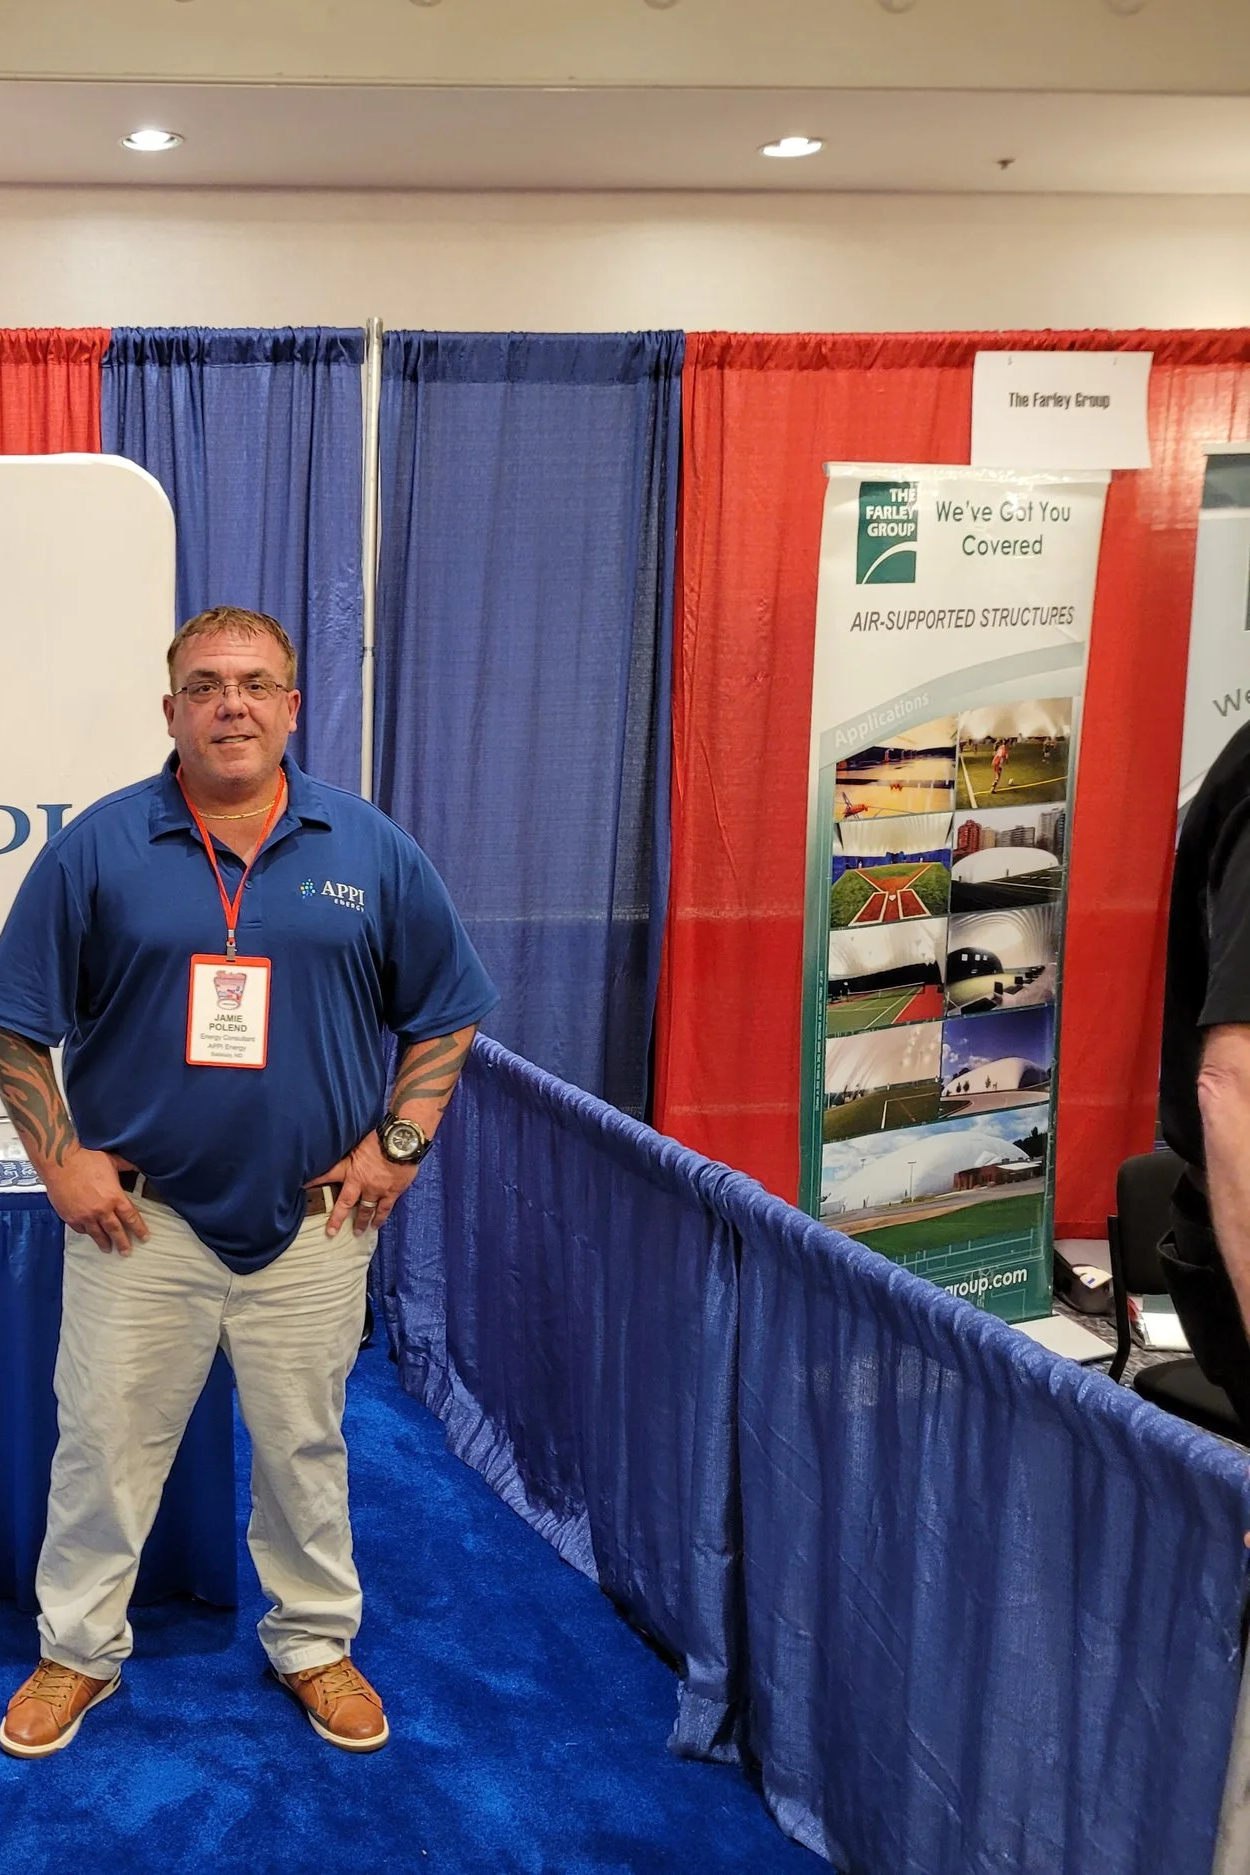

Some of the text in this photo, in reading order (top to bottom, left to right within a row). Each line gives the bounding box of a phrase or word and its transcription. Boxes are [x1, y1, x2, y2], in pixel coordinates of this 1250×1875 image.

[1008, 392, 1111, 411] The Farley Group
[889, 487, 918, 503] THE
[865, 504, 919, 521] FARLEY
[936, 500, 1071, 523] We've Got You
[866, 522, 916, 538] GROUP
[961, 534, 1043, 556] Covered
[850, 606, 1075, 633] AIR-SUPPORTED STRUCTURES
[834, 691, 930, 749] Applications
[320, 880, 365, 906] APPI
[333, 898, 365, 913] ENERGY
[214, 1014, 243, 1023] JAMIE
